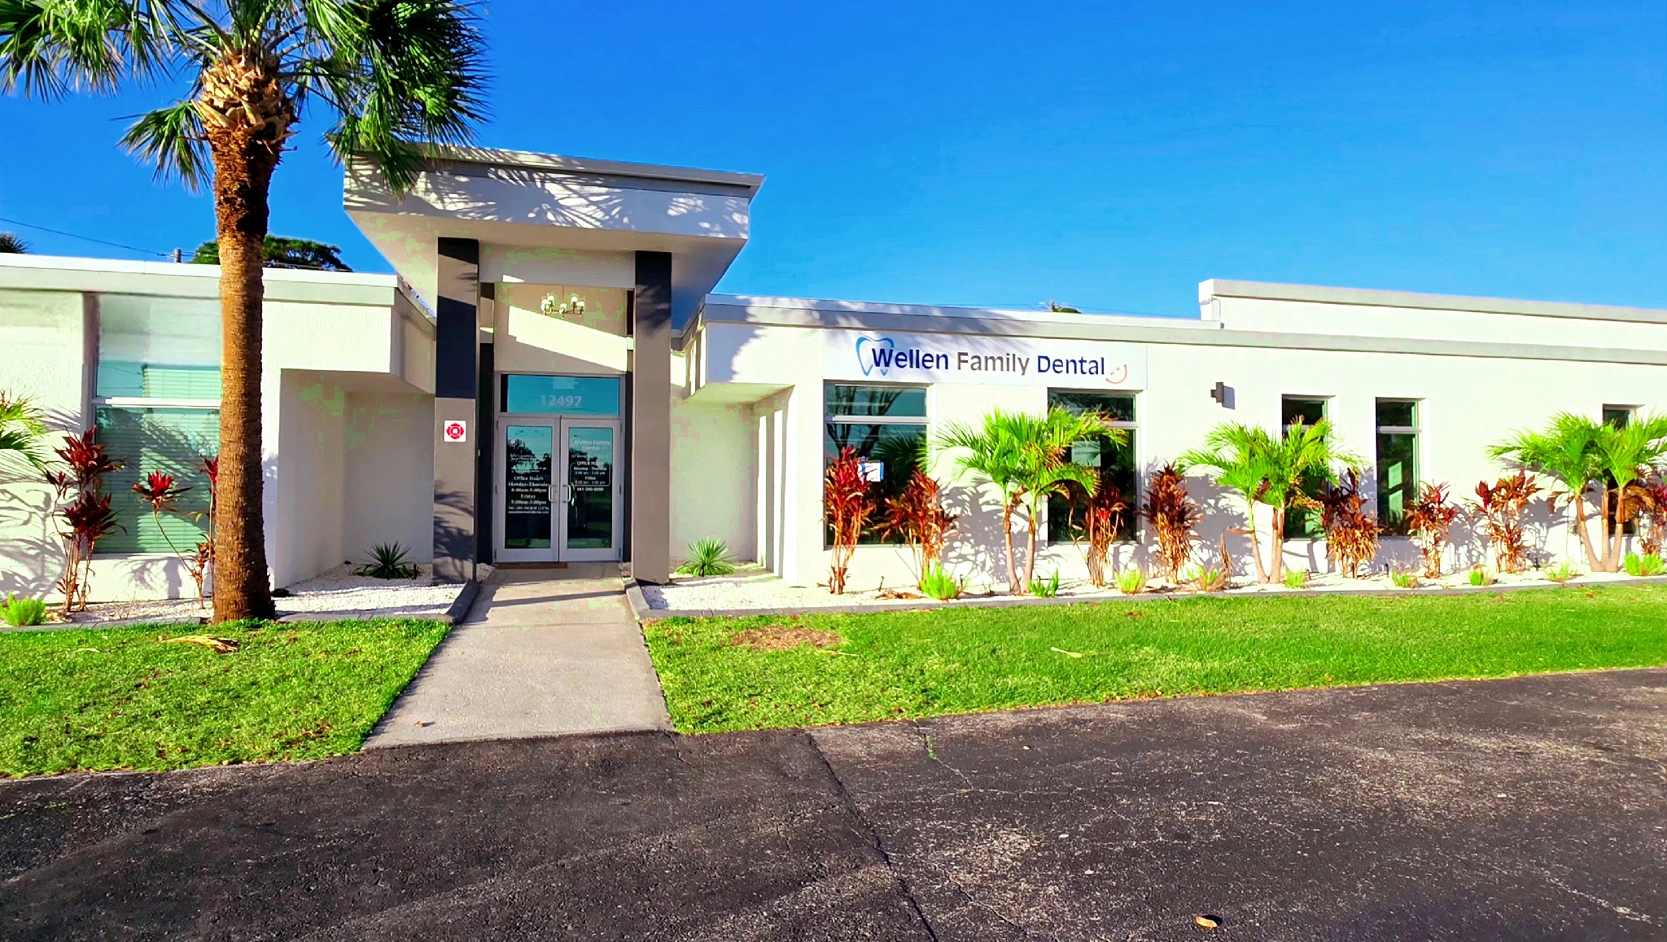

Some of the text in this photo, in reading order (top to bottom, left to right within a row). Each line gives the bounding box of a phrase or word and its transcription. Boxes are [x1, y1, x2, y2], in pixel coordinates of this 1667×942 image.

[872, 348, 1106, 376] Wellen Family Dental
[540, 395, 582, 407] 12497
